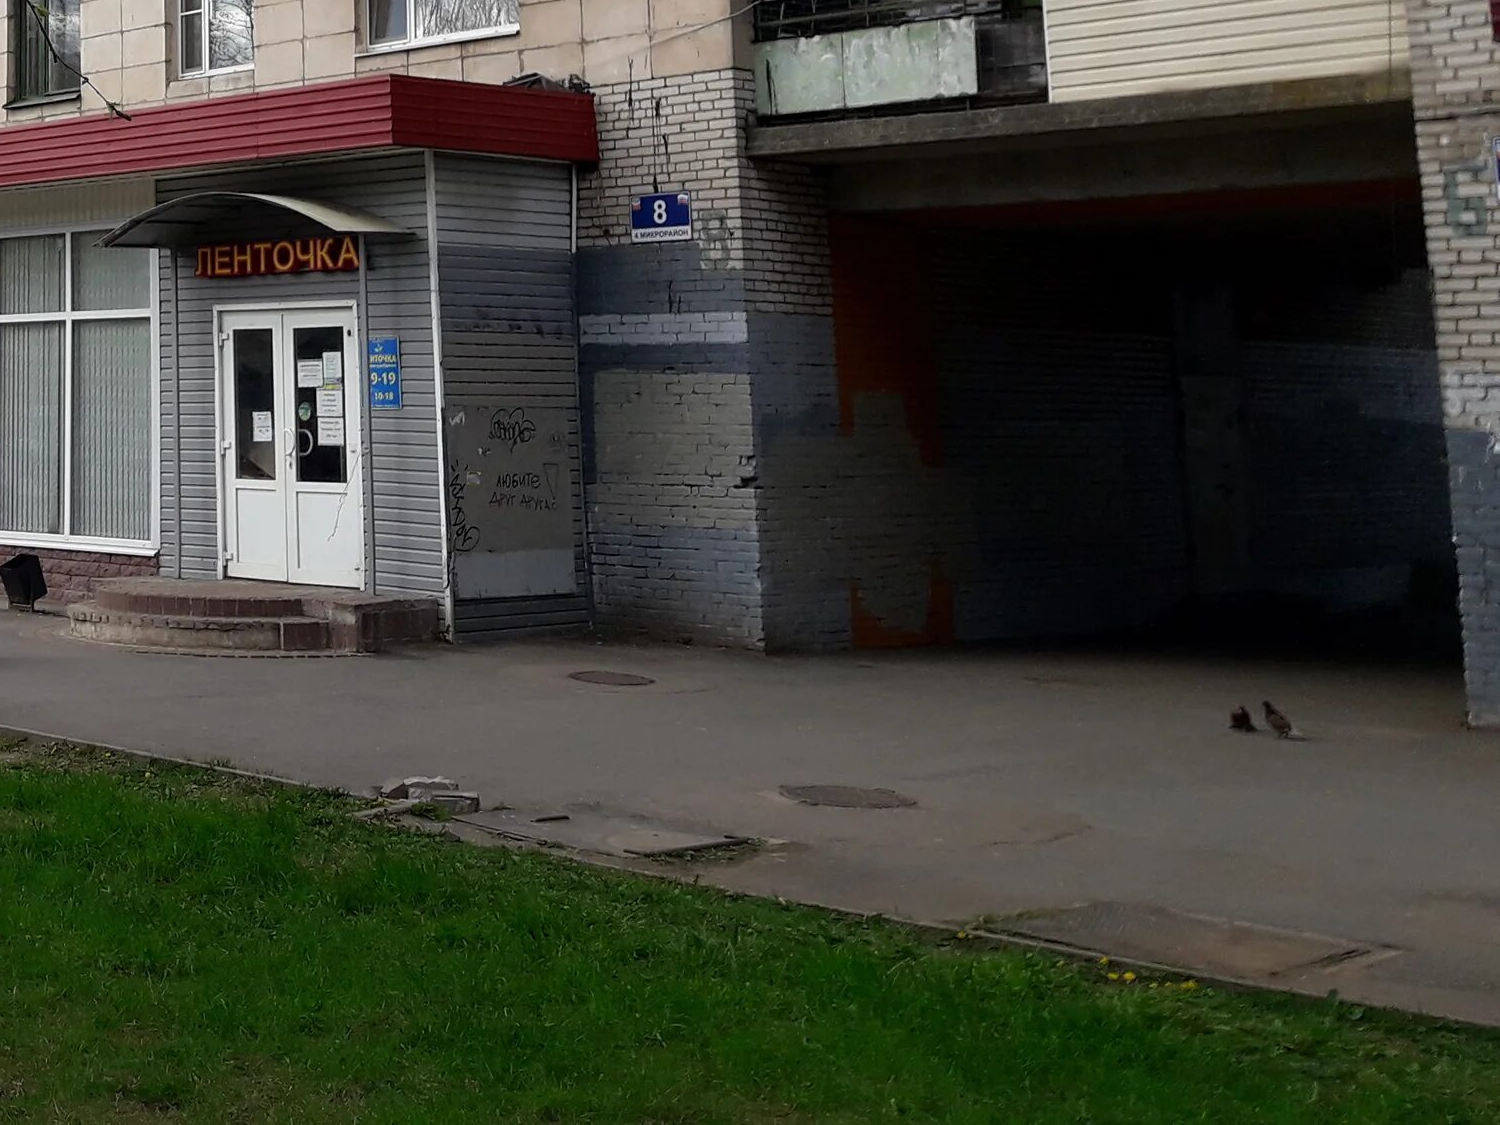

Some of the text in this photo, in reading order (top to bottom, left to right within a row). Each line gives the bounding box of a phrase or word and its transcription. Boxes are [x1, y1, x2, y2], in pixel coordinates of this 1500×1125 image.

[653, 199, 667, 224] 8
[640, 228, 689, 238] МИКРОРАЙОН
[195, 235, 359, 276] ЛЕНТОЧКА
[371, 372, 396, 385] 9-19
